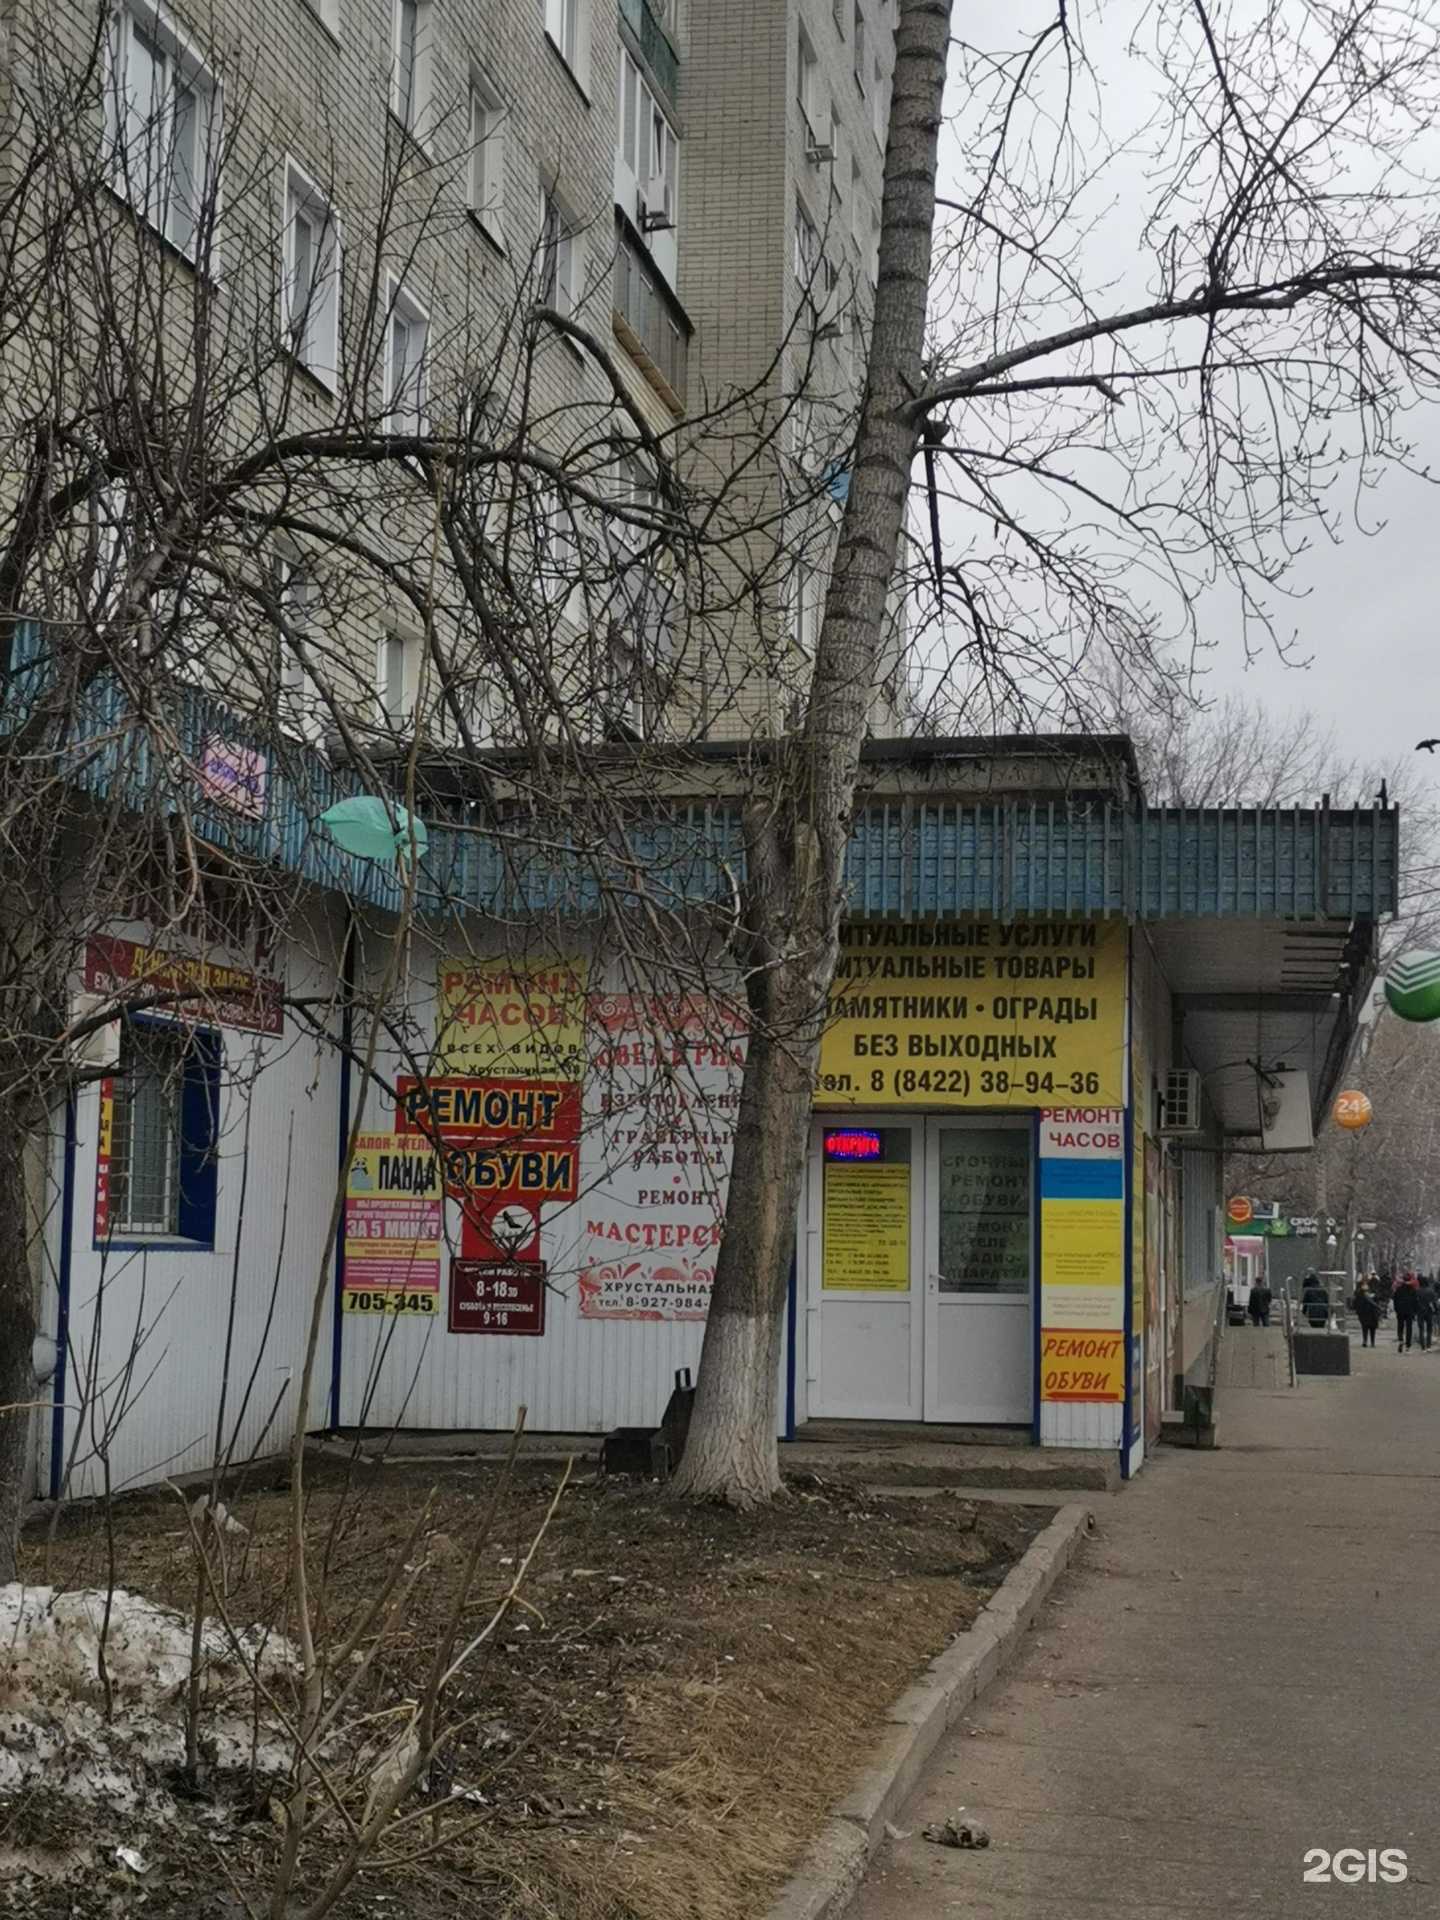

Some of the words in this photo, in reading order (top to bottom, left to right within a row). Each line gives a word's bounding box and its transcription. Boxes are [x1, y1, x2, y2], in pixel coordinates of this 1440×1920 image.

[838, 924, 989, 947] ИТУАЛЬНЫЕ
[1000, 924, 1096, 947] УСЛУГИ
[835, 956, 985, 979] ИТУАЛЬНЫЕ
[995, 957, 1095, 979] ТОВАРЫ
[456, 1002, 565, 1026] ЧАСОВ
[992, 997, 1097, 1024] ОГРАДЫ
[447, 1043, 495, 1054] ВСЕХ
[854, 1034, 898, 1057] БЕЗ
[907, 1034, 1057, 1062] ВЫХОДНЫХ
[870, 1070, 885, 1092] 8
[893, 1069, 971, 1097] (8422)
[980, 1070, 1099, 1095] 38-94-36
[406, 1085, 561, 1130] РЕМОНТ
[1337, 1099, 1360, 1113] 24
[1040, 1108, 1122, 1125] РЕМОНТ
[1050, 1132, 1121, 1149] ЧАСОВ
[634, 1151, 724, 1166] РАБОТЫ
[378, 1155, 437, 1196] ПАНДА
[448, 1150, 574, 1193] ОБУВИ
[637, 1189, 720, 1206] РЕМОНТ
[347, 1220, 368, 1238] ЗА
[370, 1220, 382, 1238] 5
[347, 1292, 434, 1312] 705-345
[1043, 1339, 1122, 1359] РЕМОНТ
[1045, 1371, 1111, 1390] ОБУВИ
